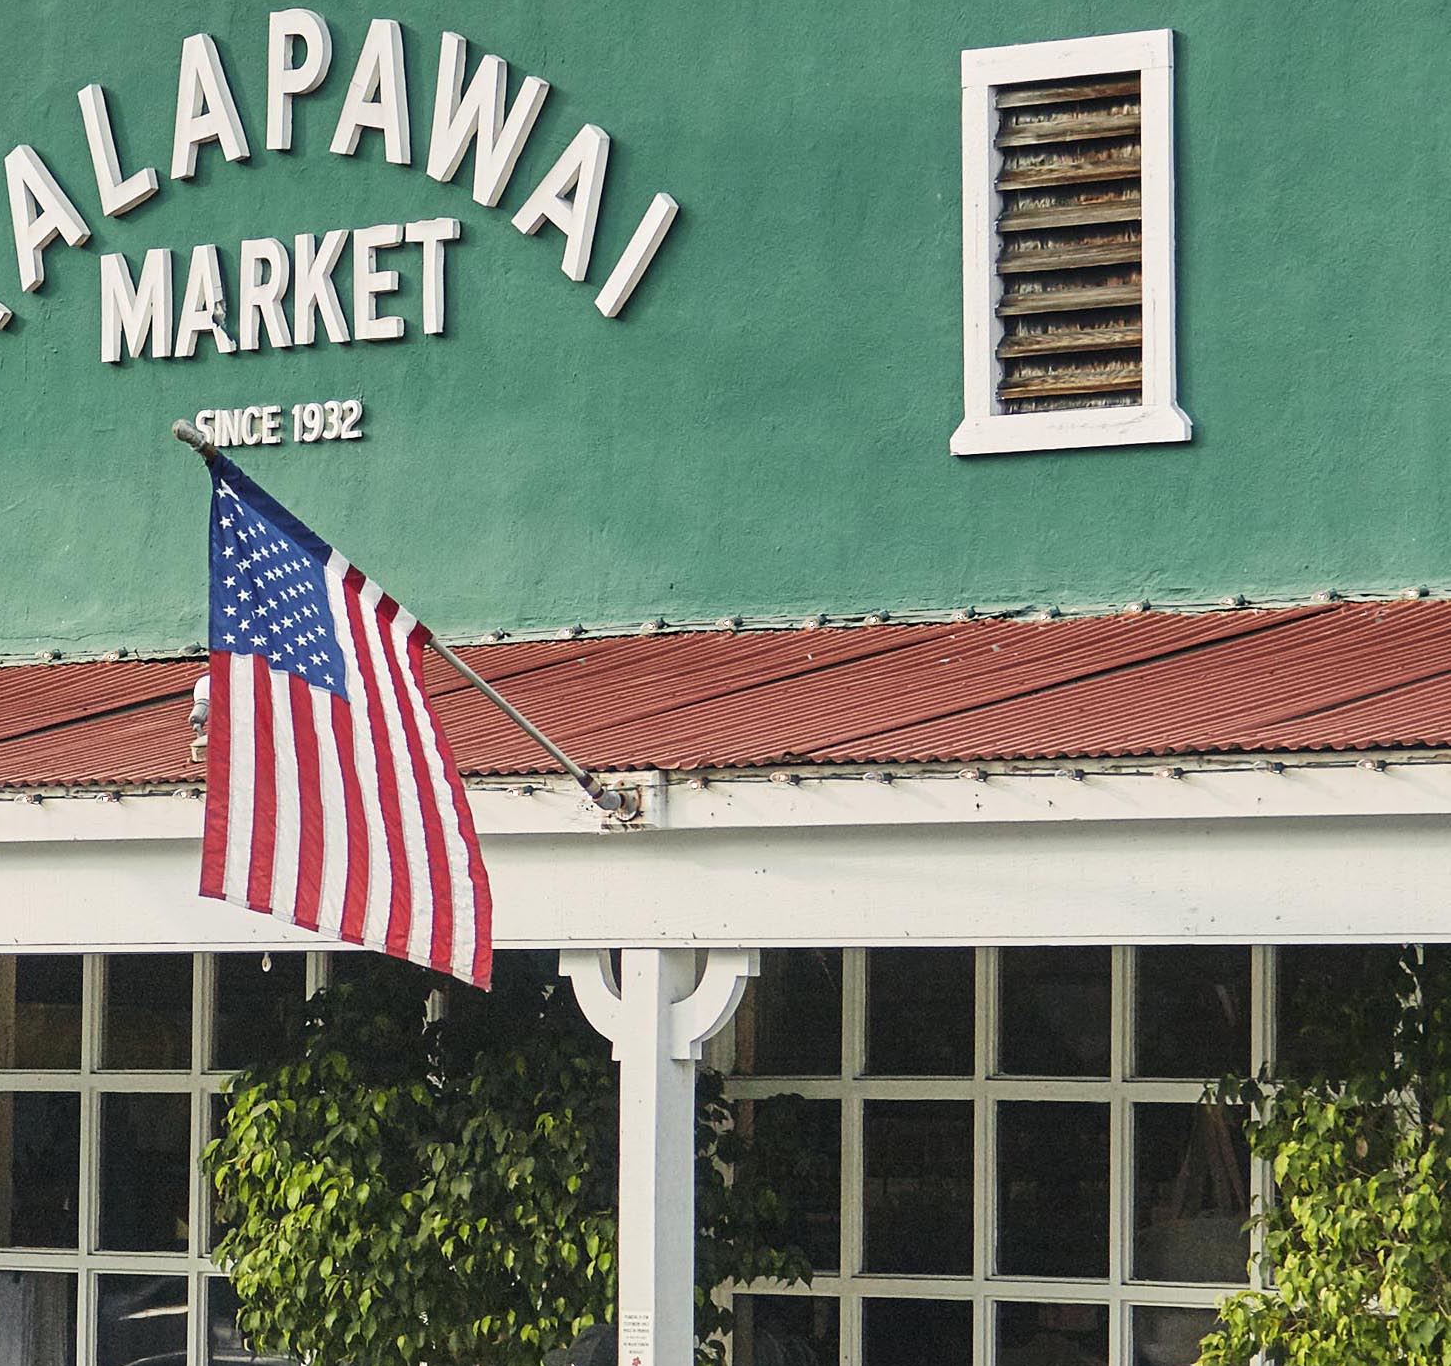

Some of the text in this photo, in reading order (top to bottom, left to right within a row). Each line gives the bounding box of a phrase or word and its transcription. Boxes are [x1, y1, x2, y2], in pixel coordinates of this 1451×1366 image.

[101, 217, 460, 363] MARKET
[195, 399, 363, 447] SINCE 1932
